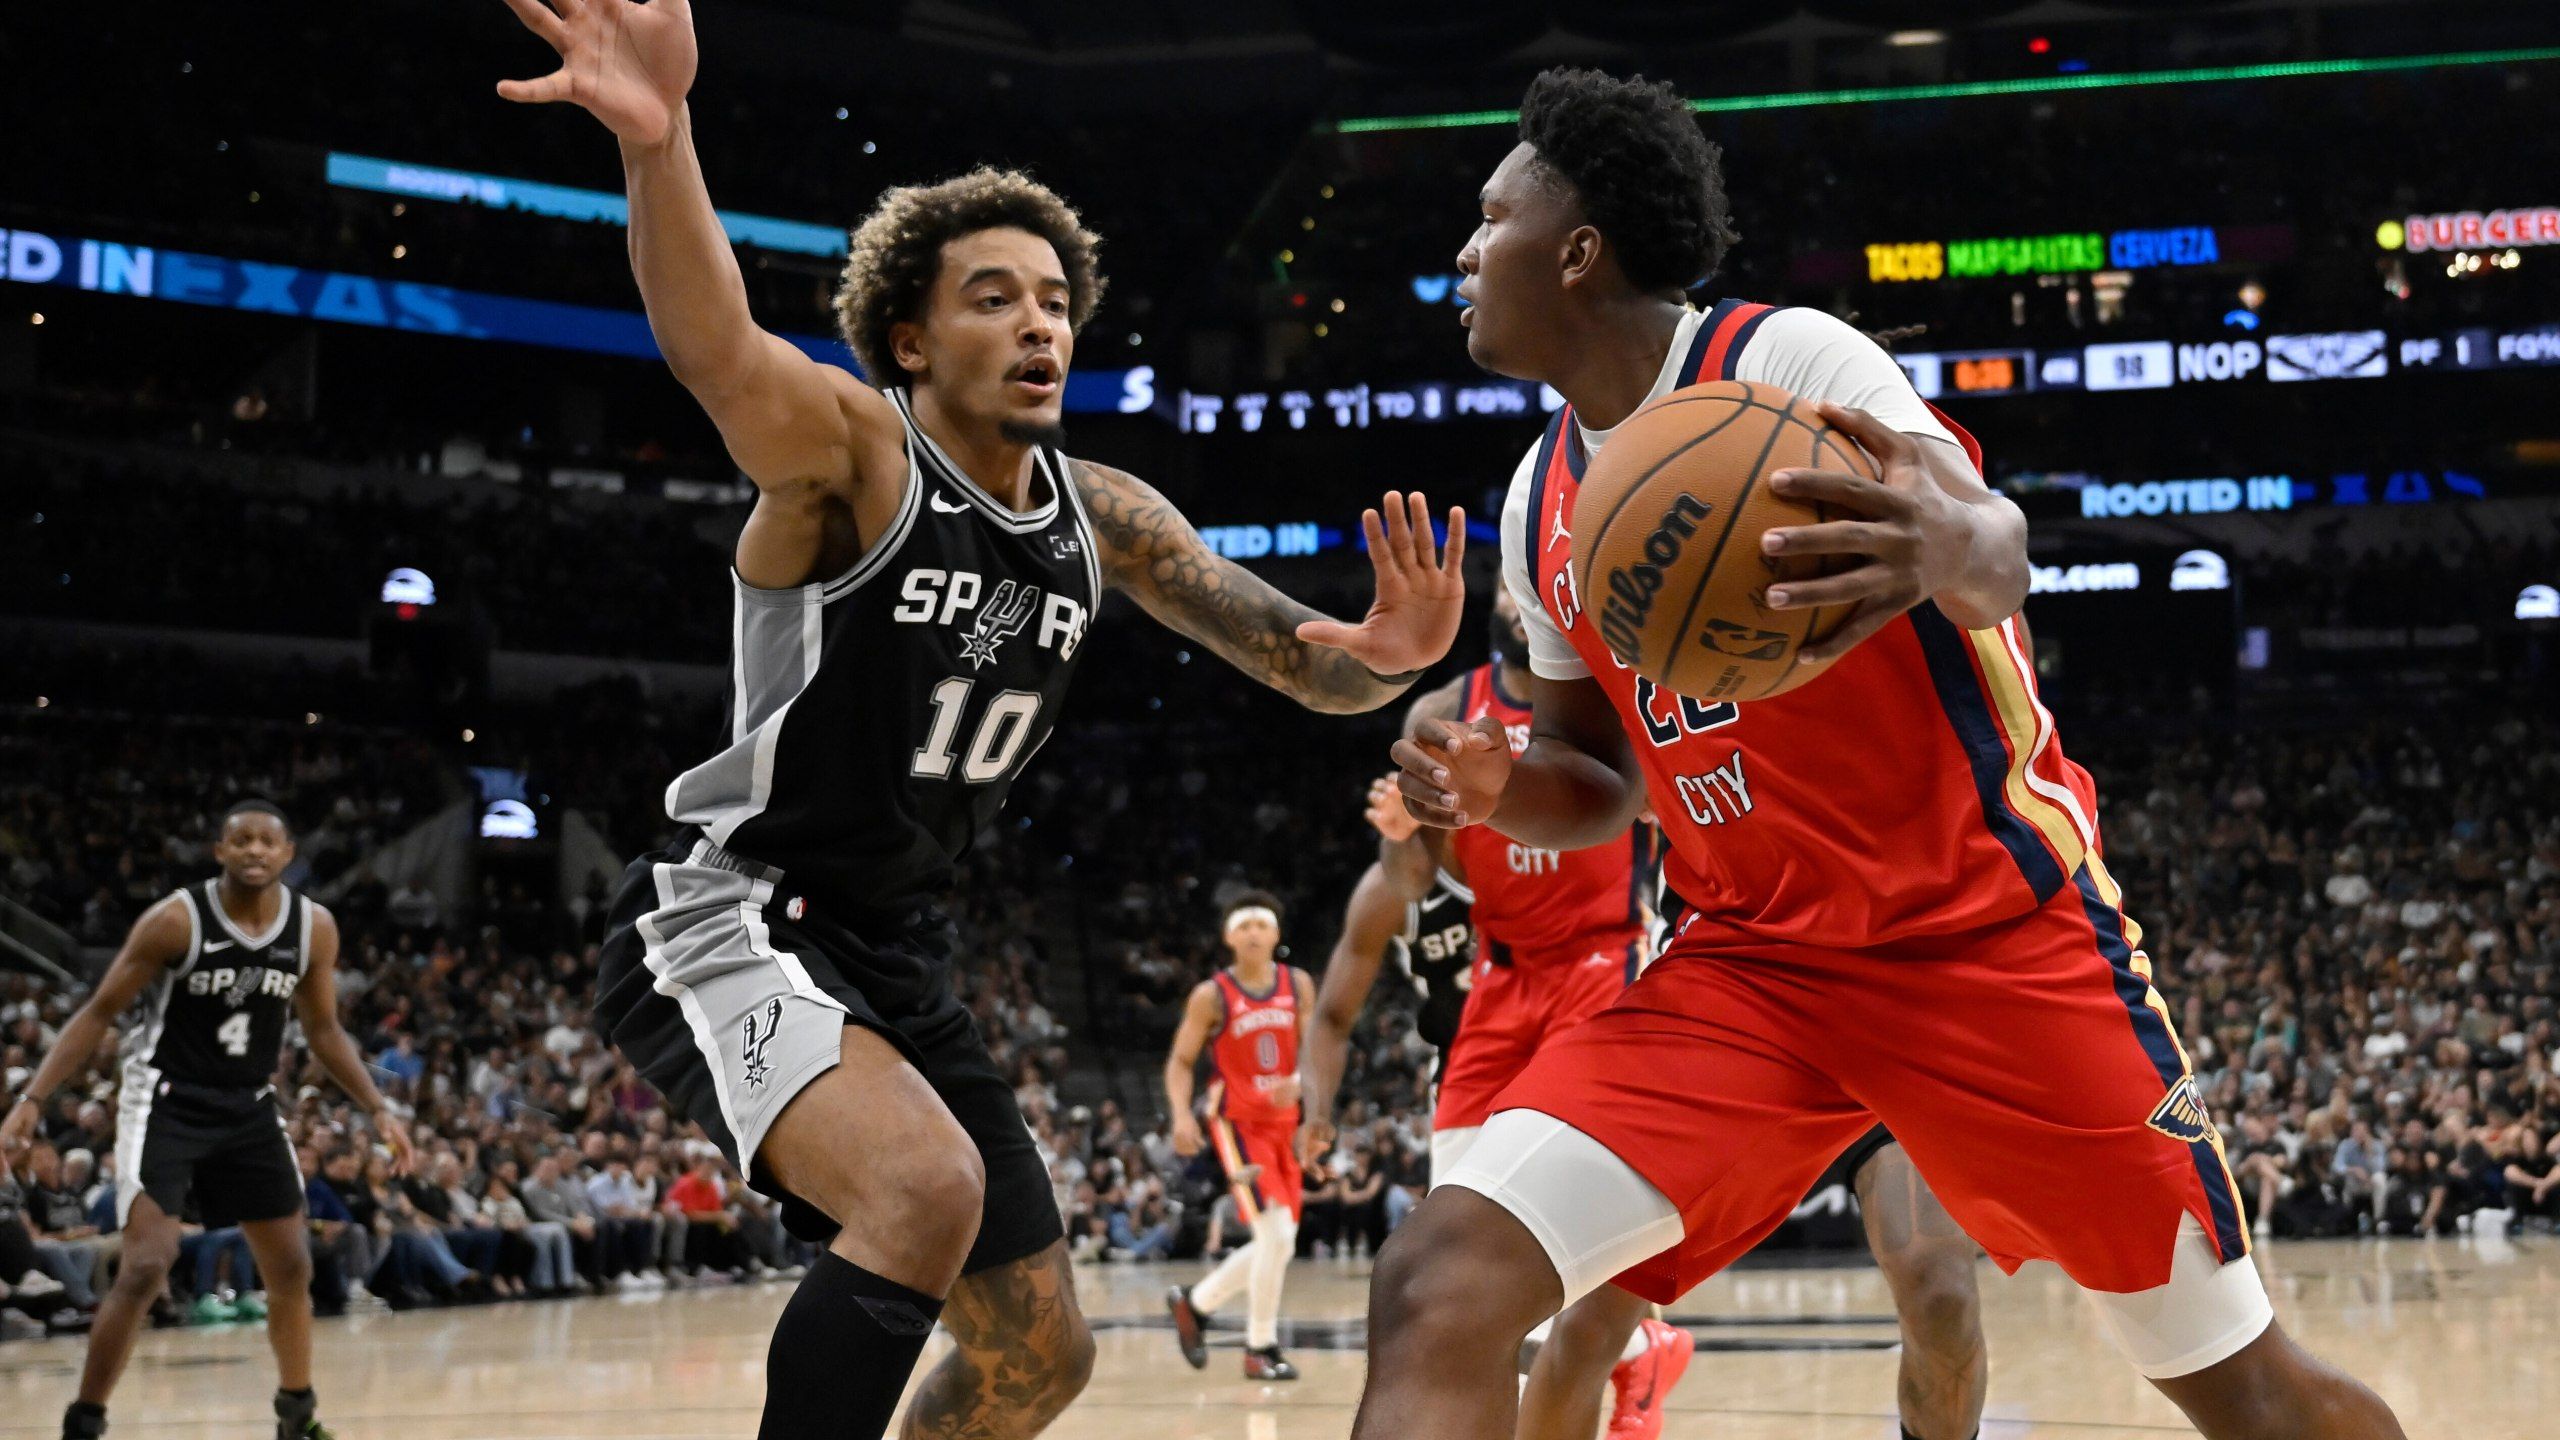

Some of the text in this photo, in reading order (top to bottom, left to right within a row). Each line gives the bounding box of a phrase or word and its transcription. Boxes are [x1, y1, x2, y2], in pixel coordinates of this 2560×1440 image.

[2405, 207, 2560, 253] BURGER
[0, 229, 153, 297] D IN
[1866, 241, 1943, 282] TACOS
[2110, 226, 2218, 268] CERVEZA
[2178, 341, 2262, 383] NOP
[2081, 475, 2293, 519] ROOTED IN
[1275, 522, 1319, 557] IN
[1600, 491, 1713, 666] Wilson
[909, 675, 1043, 784] 10
[1674, 750, 1755, 826] CITY
[1507, 842, 1560, 876] CITY
[188, 967, 299, 1006] SPURS
[216, 1011, 251, 1057] 4
